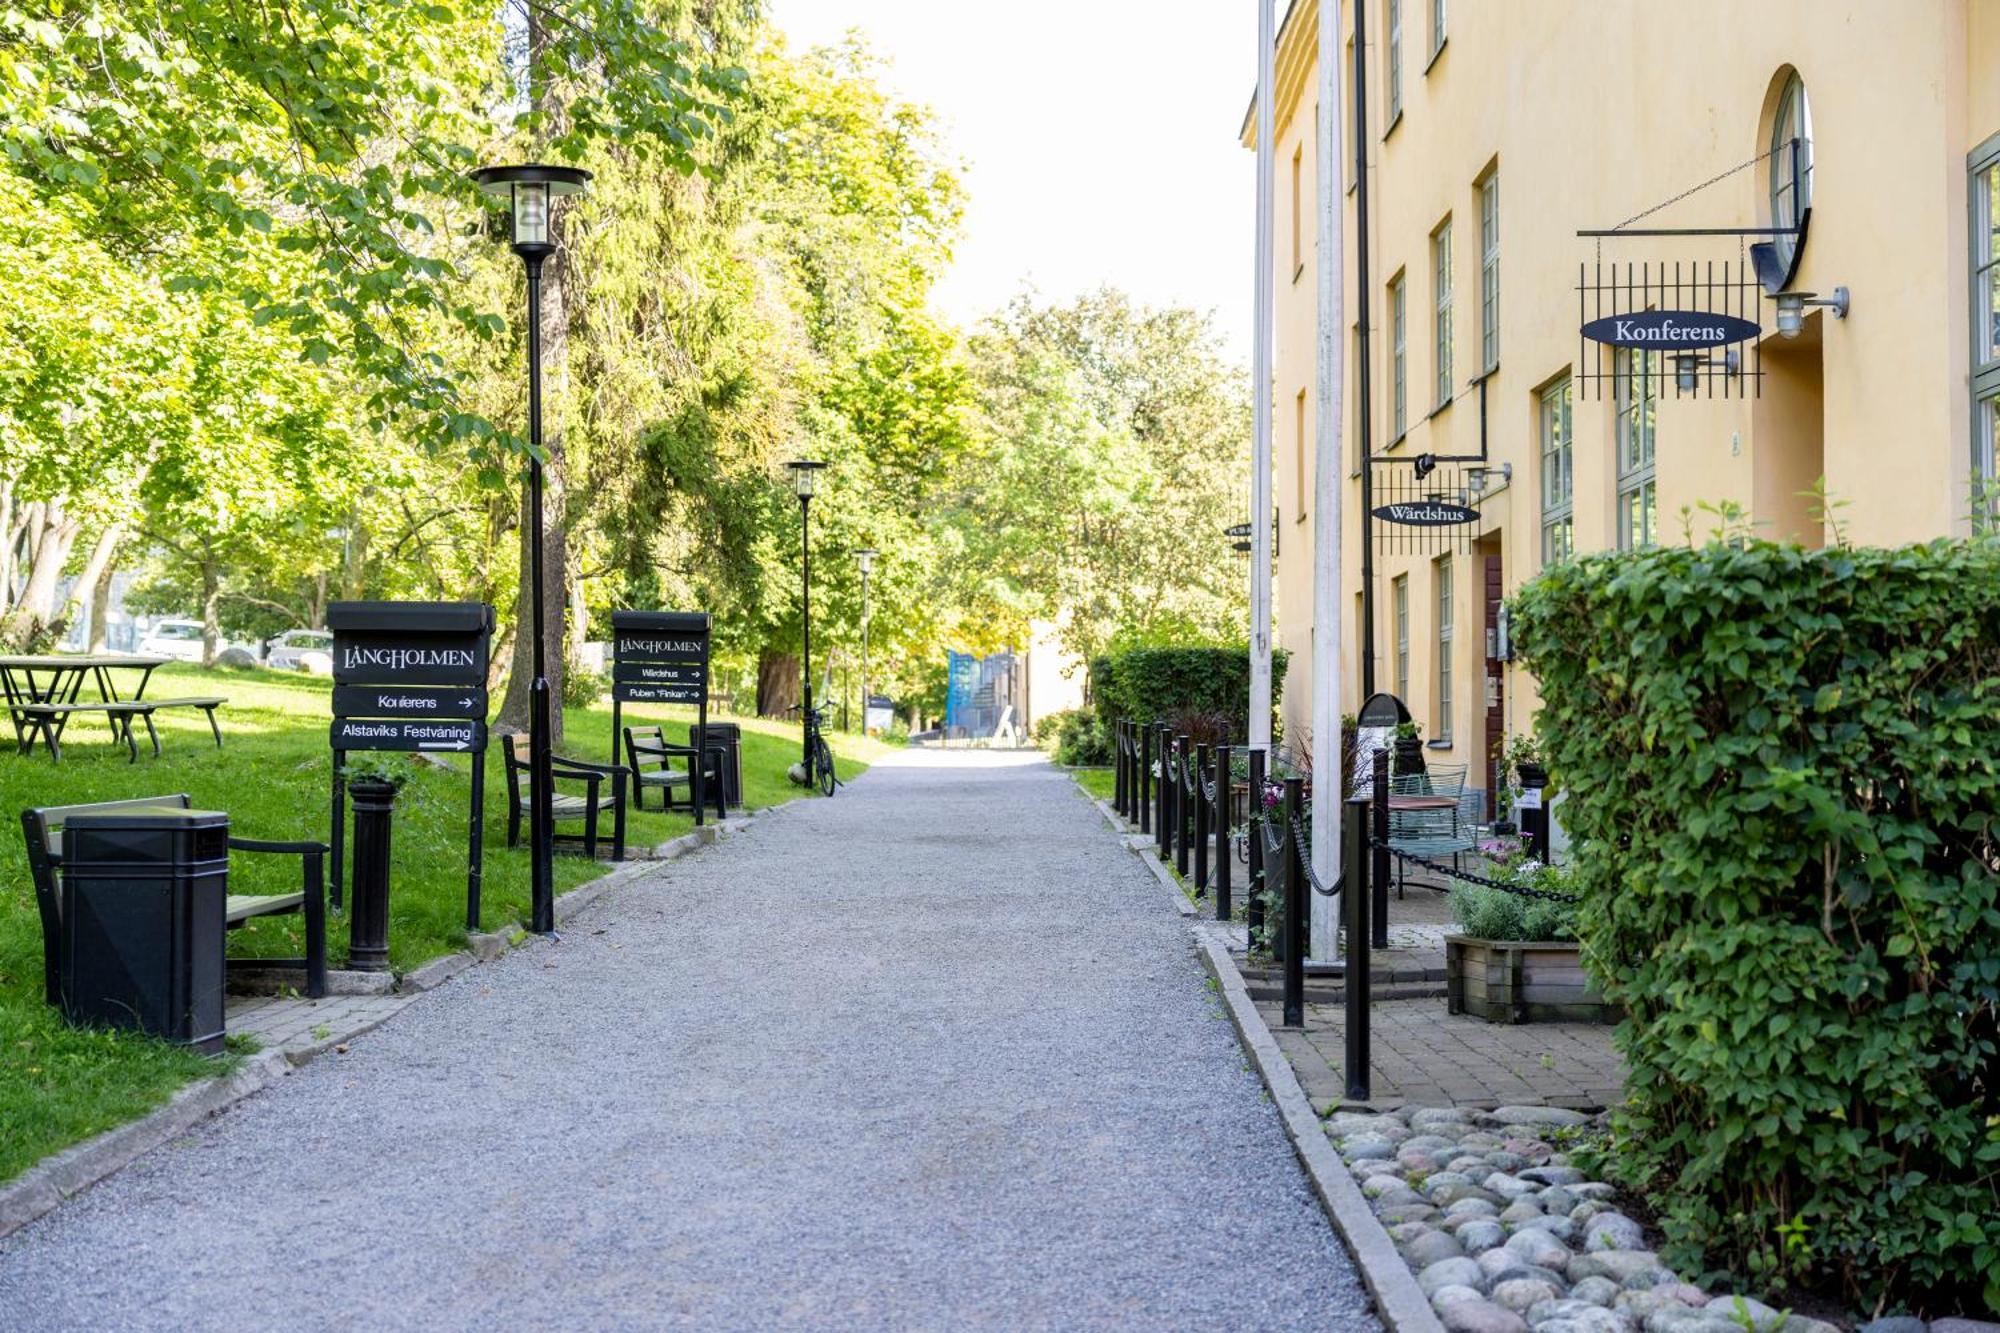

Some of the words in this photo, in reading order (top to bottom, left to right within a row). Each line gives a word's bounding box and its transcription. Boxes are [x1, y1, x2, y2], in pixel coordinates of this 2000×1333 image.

[1615, 319, 1726, 342] Konferens
[1389, 505, 1465, 521] Wärdshus
[619, 637, 702, 653] LÅNGHOLMEN
[343, 645, 474, 669] LÅNGHOLMEN
[378, 695, 437, 709] Konferens
[342, 724, 398, 737] Alstaviks
[403, 725, 471, 740] Festvåning
